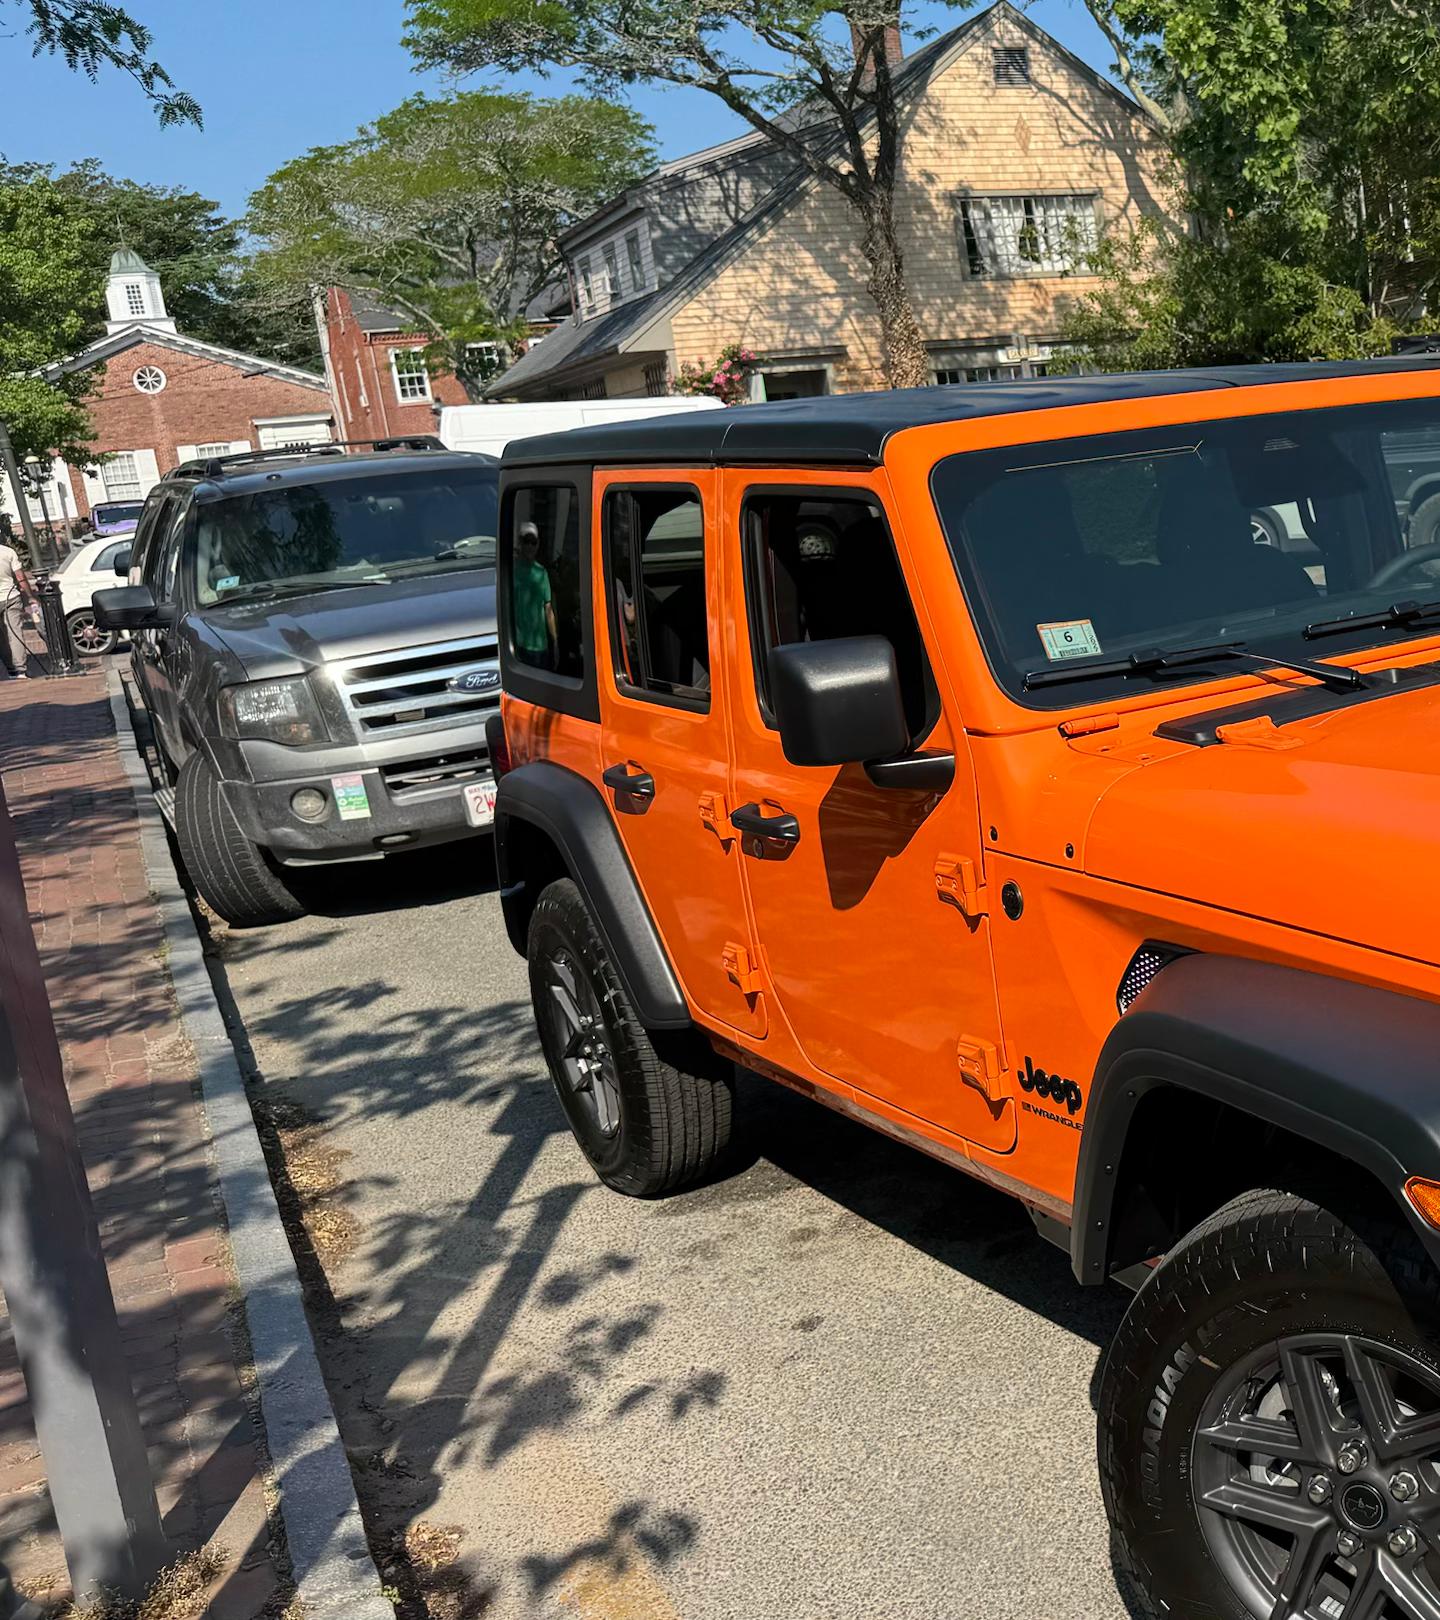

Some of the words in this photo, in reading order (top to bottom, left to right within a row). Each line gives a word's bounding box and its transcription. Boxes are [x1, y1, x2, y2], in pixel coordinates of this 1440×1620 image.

[1063, 631, 1073, 642] 6
[465, 672, 498, 688] Ford
[1017, 1055, 1083, 1115] Jeep
